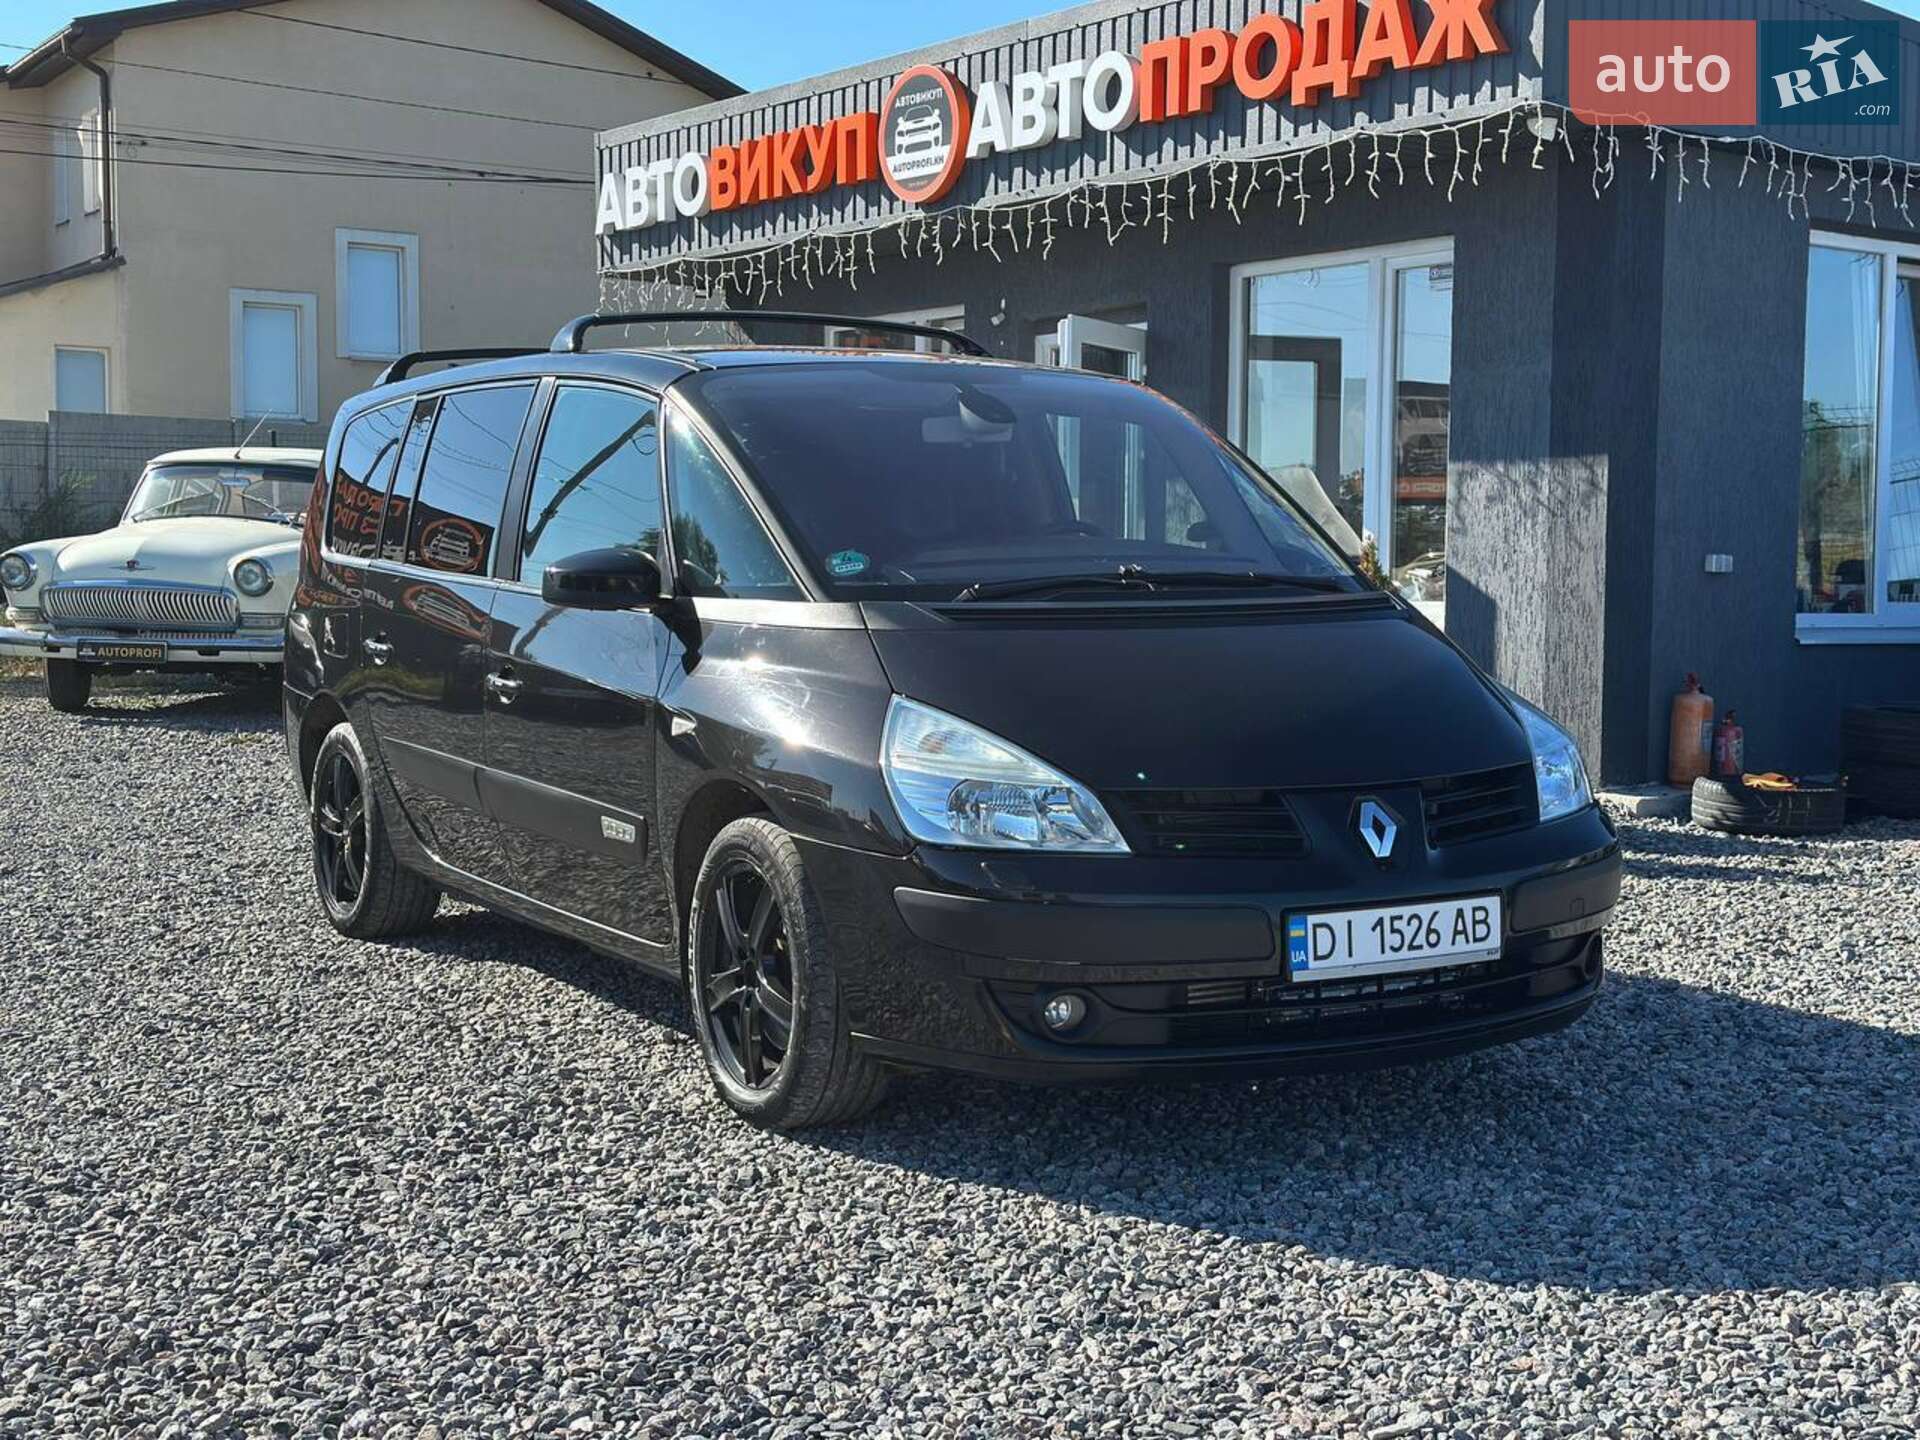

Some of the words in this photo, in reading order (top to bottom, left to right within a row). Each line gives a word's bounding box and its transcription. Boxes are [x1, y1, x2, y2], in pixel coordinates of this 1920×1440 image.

[595, 112, 872, 236] АВТОВИКУП
[965, 0, 1503, 159] АВТОПРОДАЖ
[97, 647, 162, 658] AUTOPROFI
[1312, 919, 1353, 961] DI
[1371, 910, 1441, 955] 1526
[1451, 905, 1491, 946] AB
[1291, 949, 1307, 963] UA
